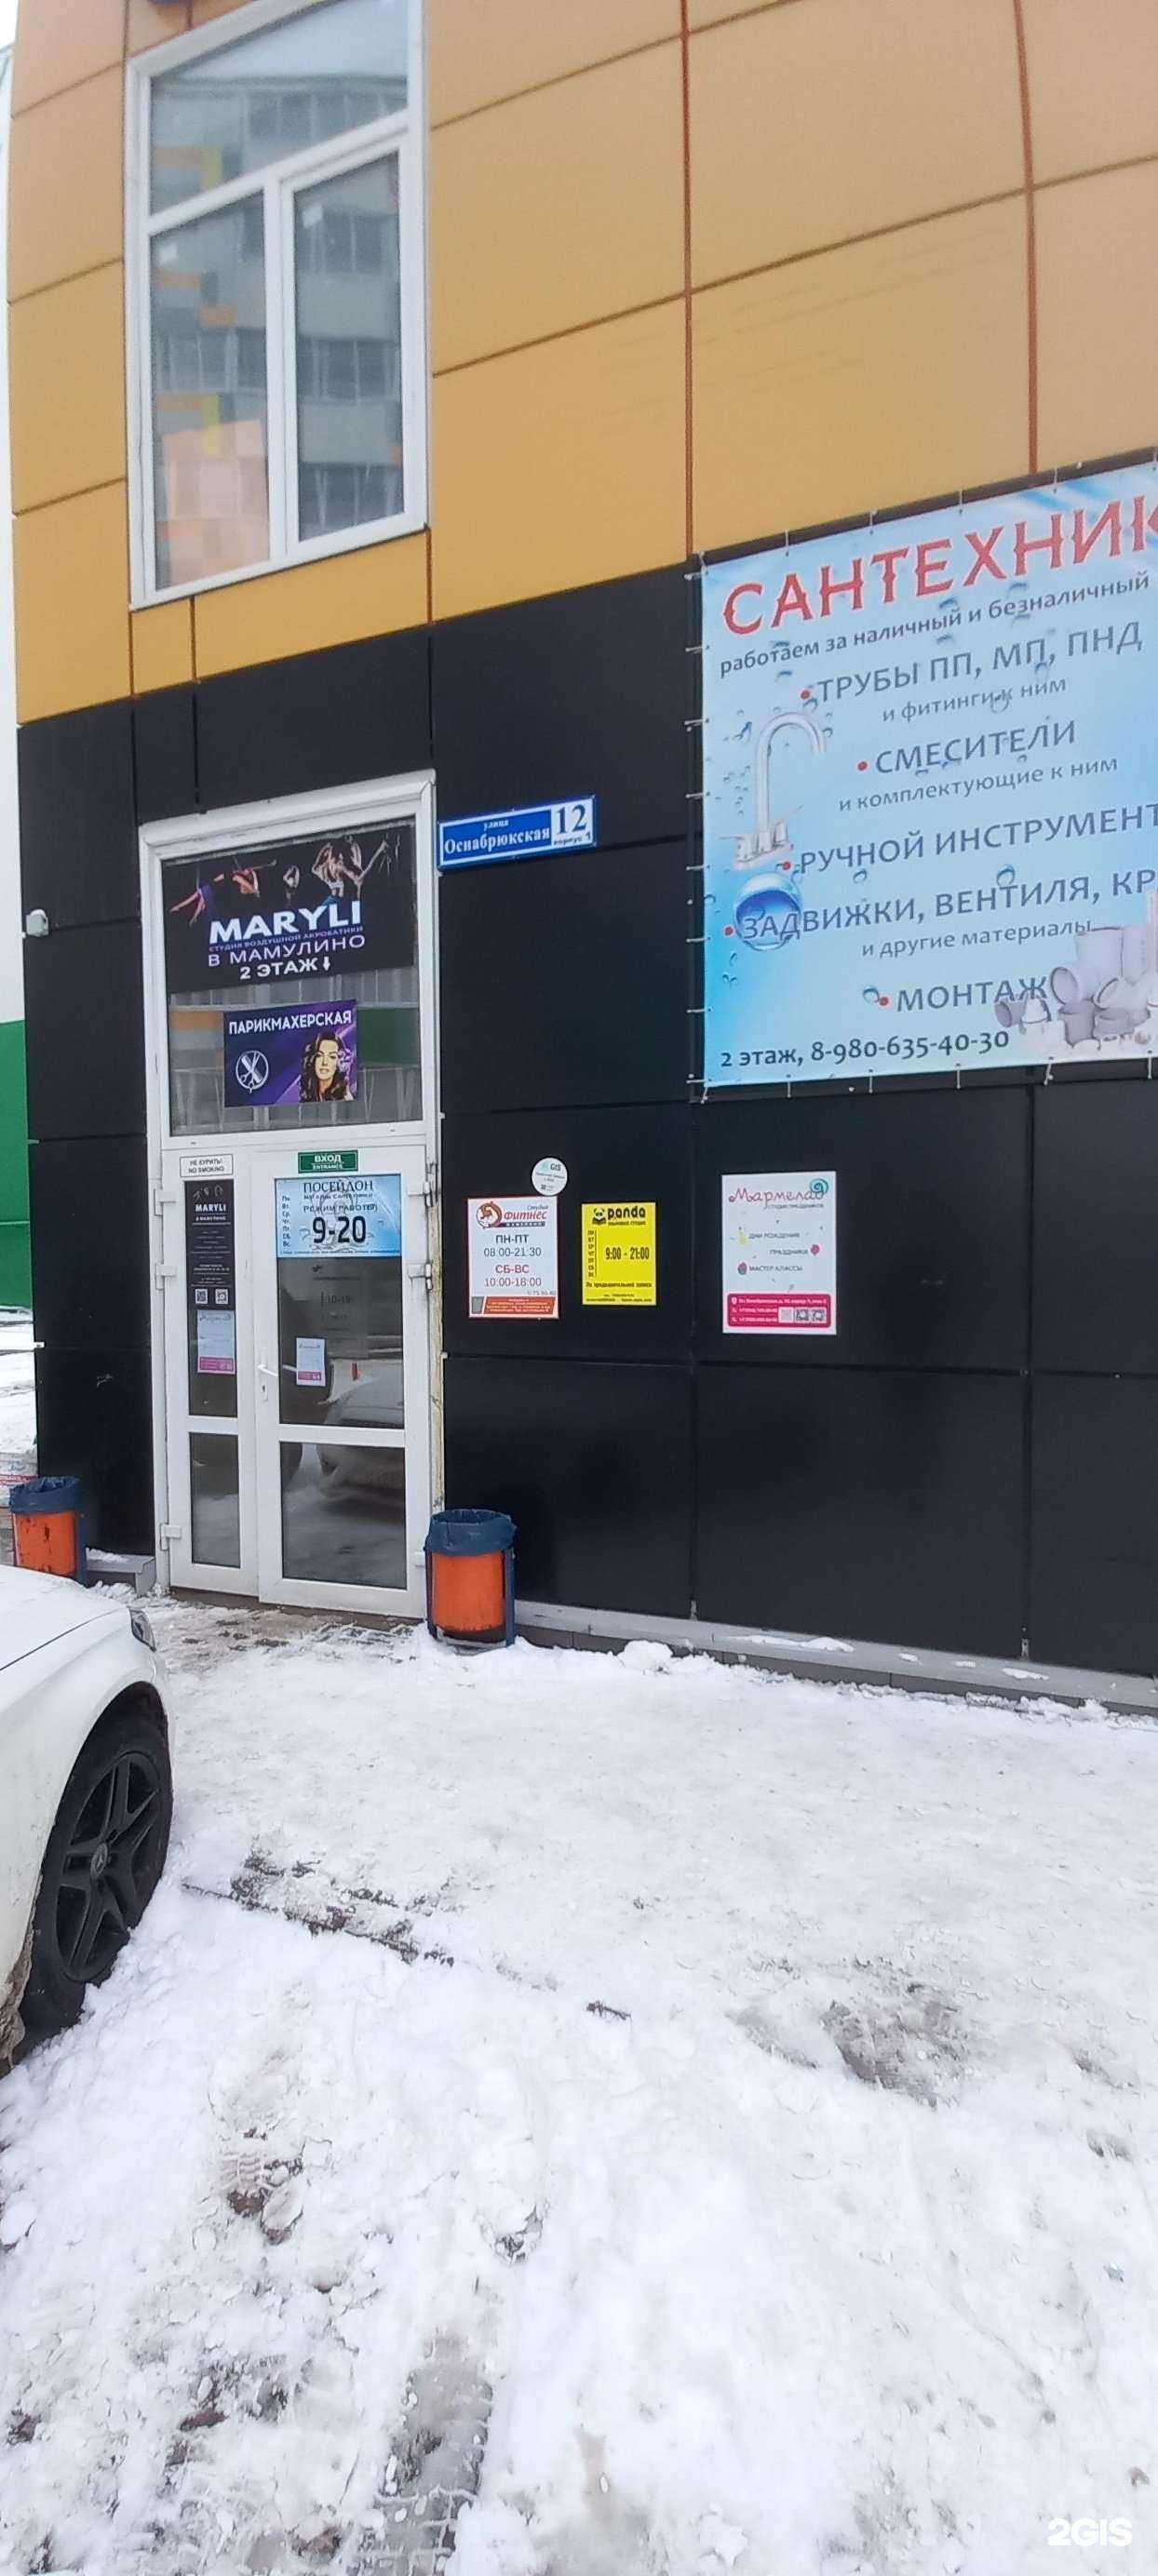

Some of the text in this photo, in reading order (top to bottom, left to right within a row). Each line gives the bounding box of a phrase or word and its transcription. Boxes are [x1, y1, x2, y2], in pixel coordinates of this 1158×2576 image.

[720, 570, 1149, 678] работаем за наличный и безналичный
[817, 621, 1143, 703] ТРУБЫ ПП, МП, ПНД
[882, 678, 1067, 722] и фитинги к ним
[875, 719, 1075, 774] СМЕСИТЕЛИ
[840, 758, 1119, 812] и комплектующие к ним
[483, 820, 509, 831] улица
[556, 803, 587, 835] 12
[444, 826, 550, 854] Оснабрюкская
[801, 831, 923, 874] РУЧНОЙ
[744, 869, 1158, 941] ЗАДВИЖКИ, ВЕНТИЛЯ, КР
[209, 901, 360, 945] MARYLI
[209, 942, 243, 952] СТУДИЯ
[209, 934, 366, 966] В МАМУЛИНО
[861, 919, 1091, 959] и другие материалы
[240, 957, 318, 980] 2 ЭТАЖ
[896, 974, 1048, 1013] МОНТАЖ
[228, 1010, 352, 1035] ПАРИКМАХЕРСКАЯ
[720, 1030, 1010, 1067] 2 этаж, 8-980-635-40-30
[315, 1154, 342, 1163] ВХОД
[303, 1179, 373, 1192] ПОСЕЙДОН
[729, 1187, 824, 1209] Мармелад
[195, 1203, 227, 1213] MARYLI
[504, 1211, 547, 1220] Фитнес
[607, 1206, 646, 1220] panda
[312, 1215, 367, 1243] 9-20
[495, 1234, 530, 1244] ПН-ПТ
[483, 1246, 542, 1257] 08:00-21:30
[605, 1246, 622, 1260] 9:00
[630, 1246, 650, 1260] 21:00
[484, 1277, 542, 1287] 10:00-18:00
[495, 1264, 530, 1274] СБ-ВС
